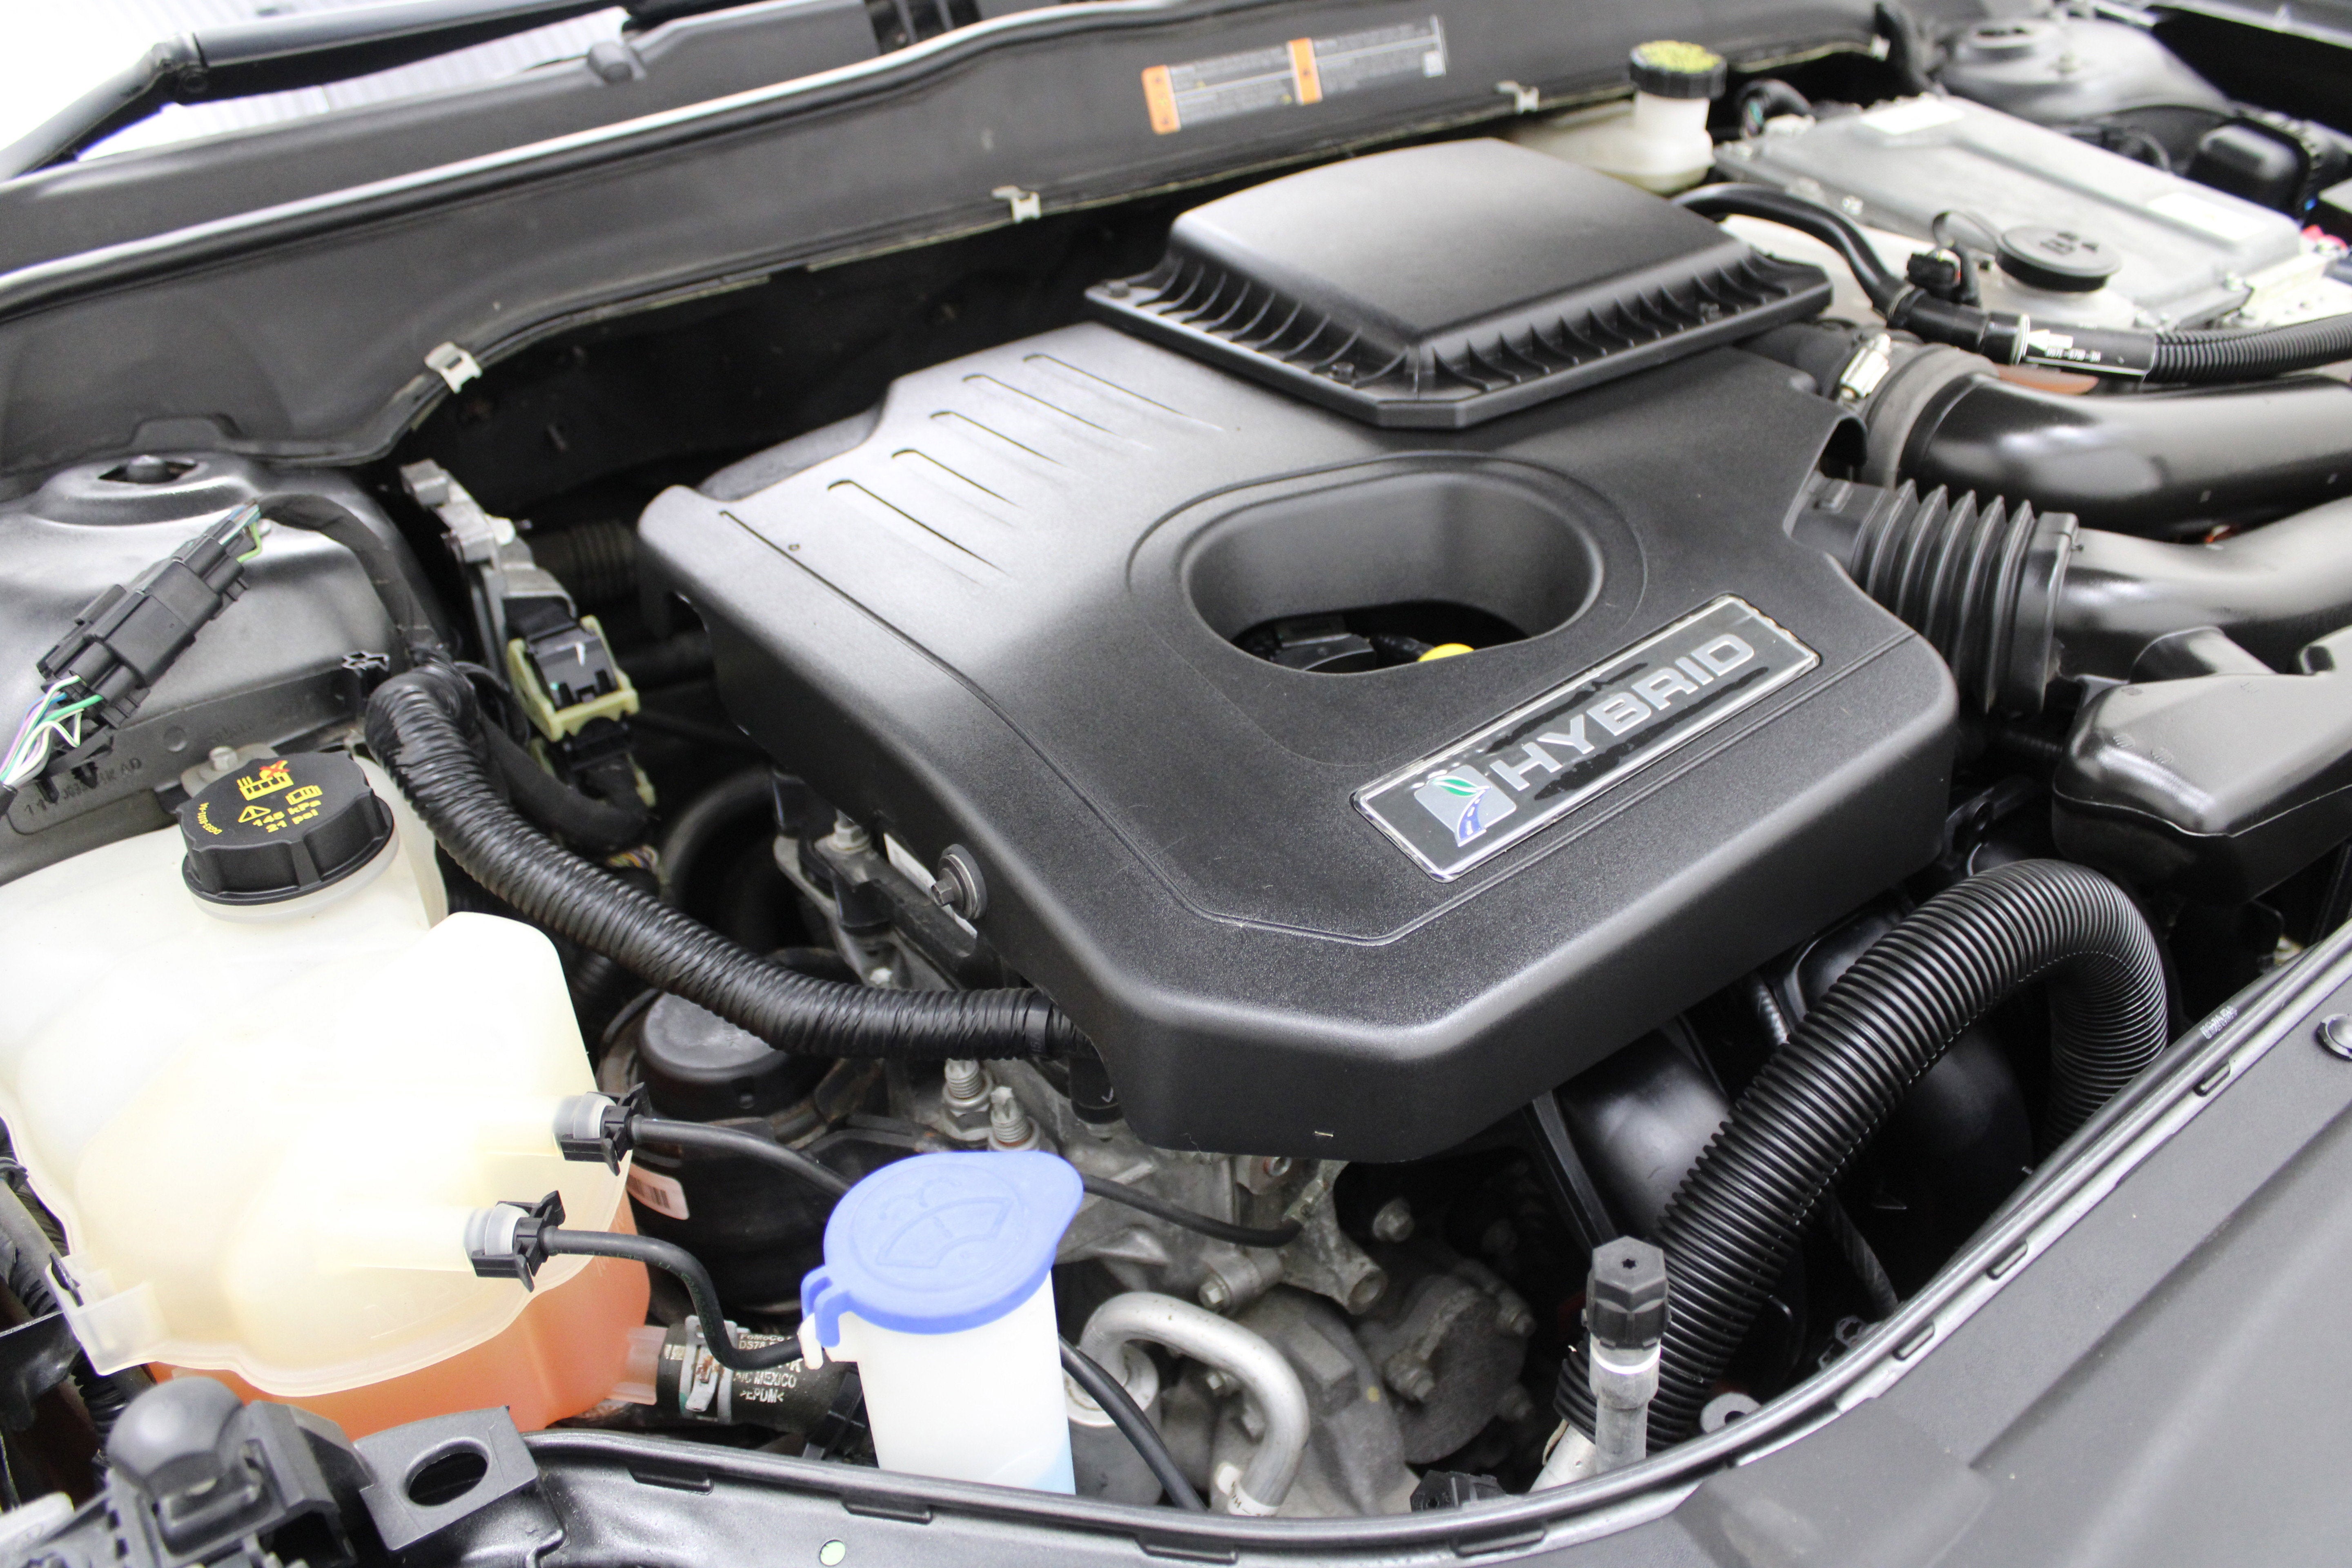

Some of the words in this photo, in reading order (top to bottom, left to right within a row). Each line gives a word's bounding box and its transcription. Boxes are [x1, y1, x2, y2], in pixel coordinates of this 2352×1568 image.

[1490, 633, 1755, 792] HYBRID
[253, 811, 285, 826] 145
[287, 800, 322, 814] kPa
[266, 820, 287, 833] 21
[292, 809, 318, 825] psi
[740, 1334, 785, 1342] FoMoCo
[754, 1371, 797, 1388] MEXICO
